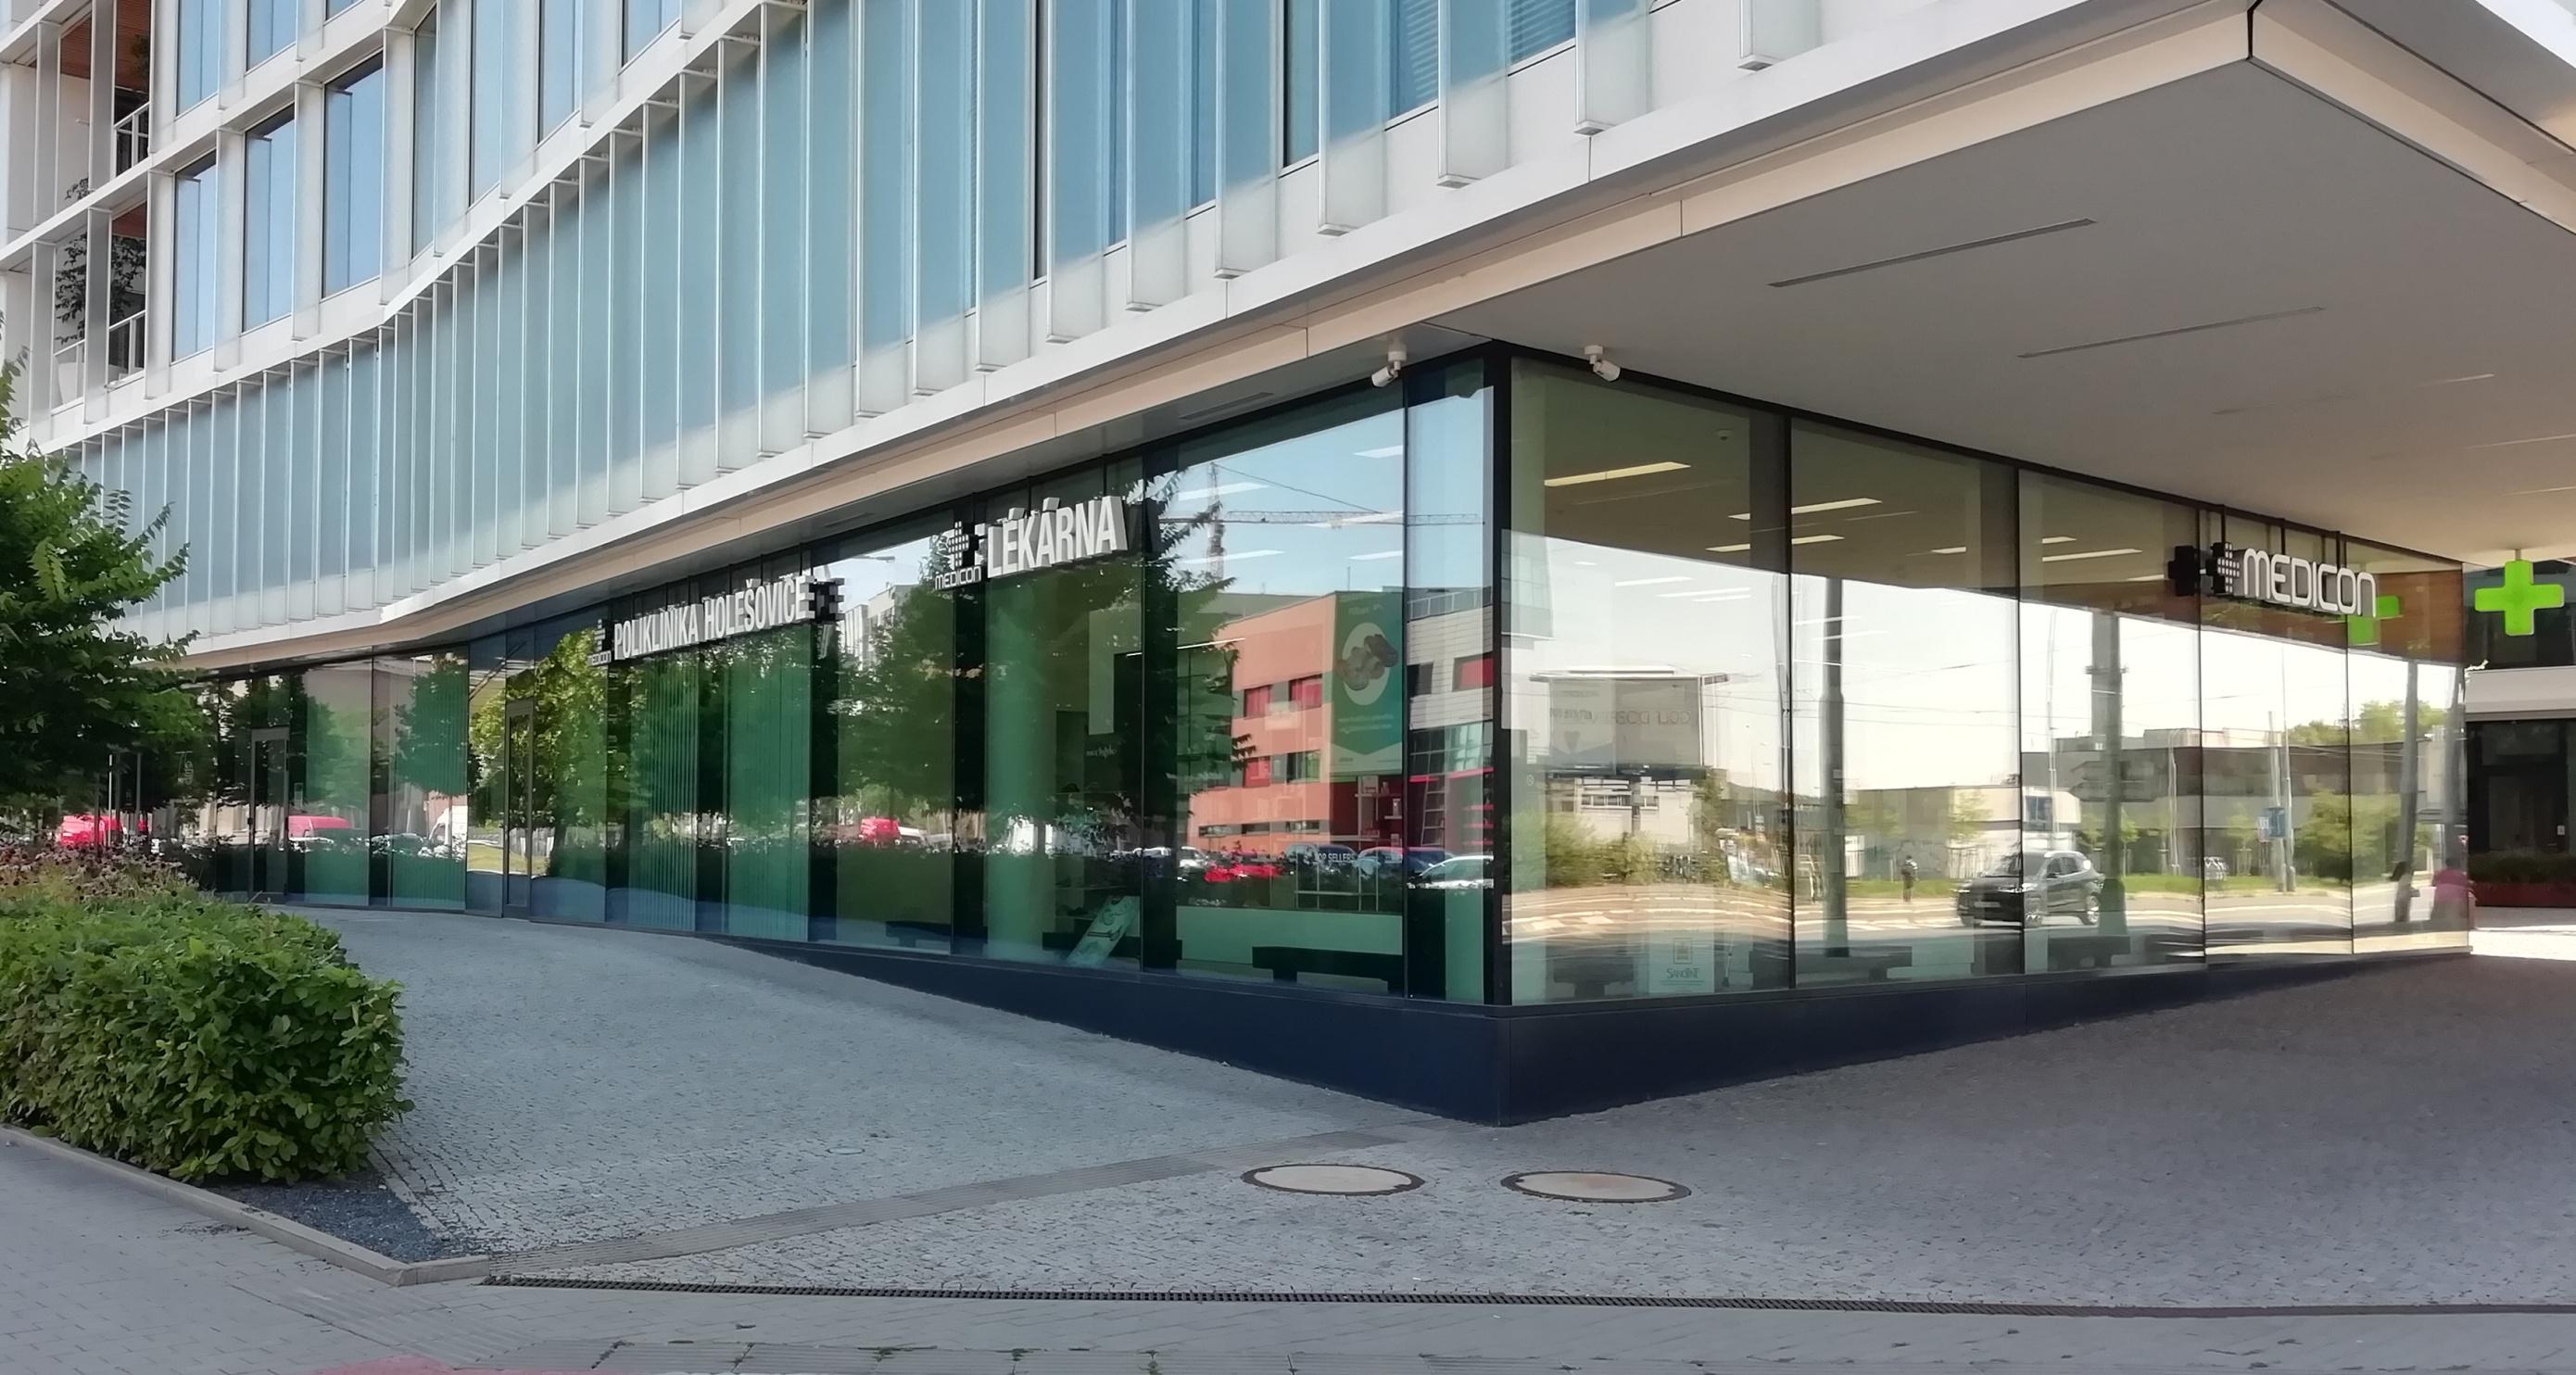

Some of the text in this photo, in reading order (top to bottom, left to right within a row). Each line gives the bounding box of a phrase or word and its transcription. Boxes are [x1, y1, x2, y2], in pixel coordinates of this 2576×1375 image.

[987, 497, 1127, 578] LÉKÁRNA
[935, 565, 982, 591] MEDICON
[2243, 548, 2377, 618] MEDICON
[614, 576, 814, 661] POLIKLINIKA HOLEŠOVICE
